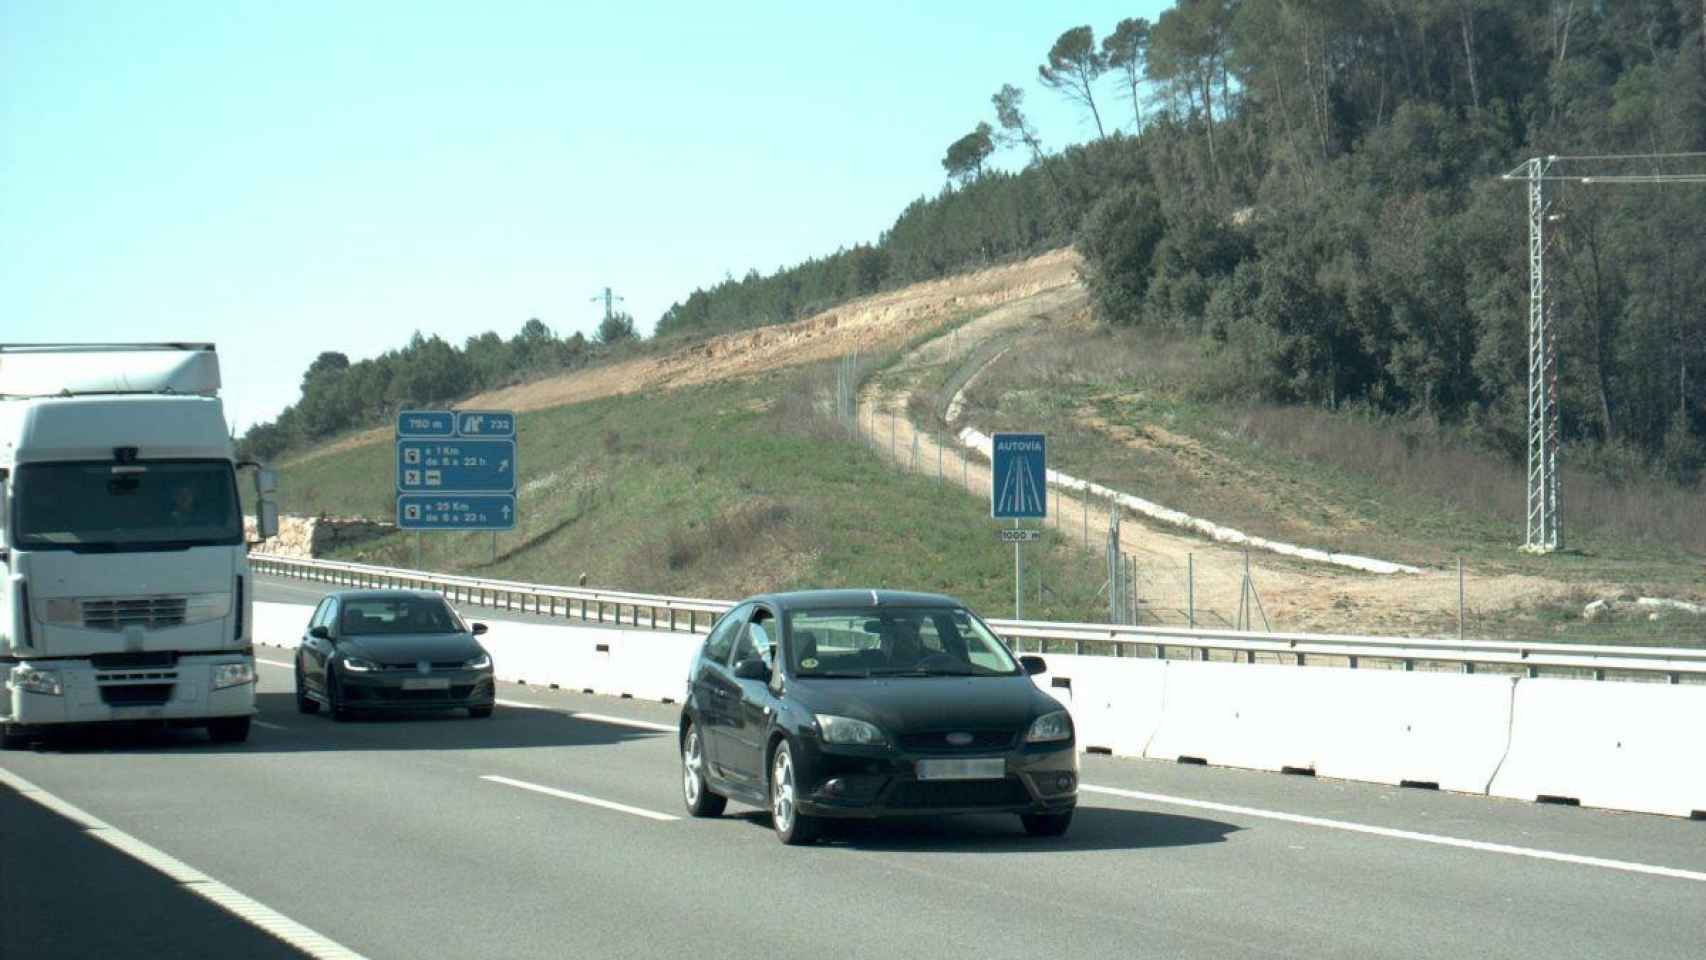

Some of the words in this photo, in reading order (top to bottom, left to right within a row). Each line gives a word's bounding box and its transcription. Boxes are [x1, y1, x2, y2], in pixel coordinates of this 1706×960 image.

[479, 457, 486, 465] h
[452, 503, 470, 511] Km
[479, 513, 486, 521] h
[1003, 530, 1026, 539] 1000
